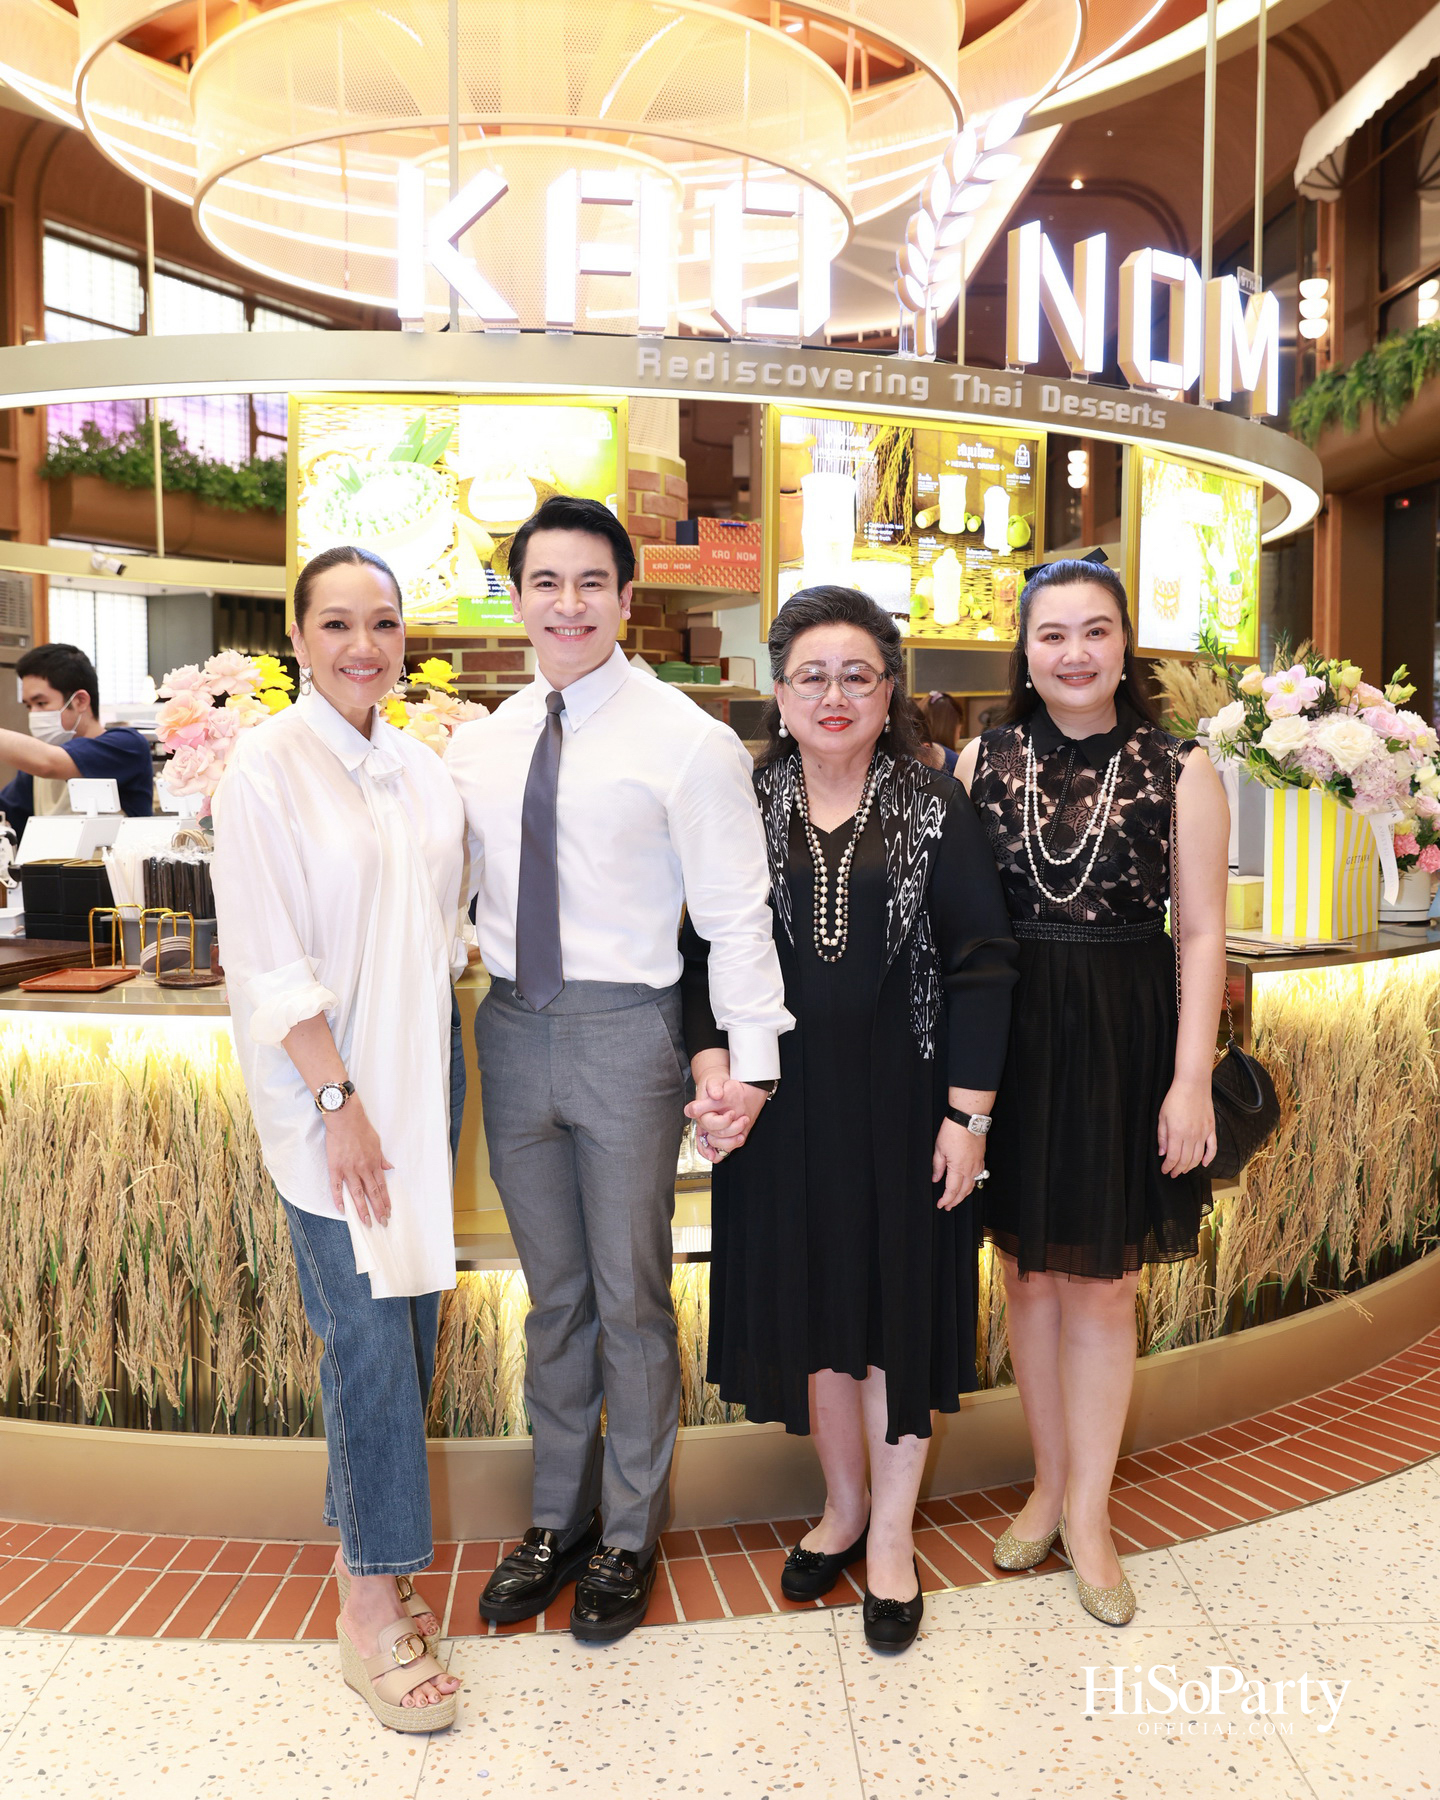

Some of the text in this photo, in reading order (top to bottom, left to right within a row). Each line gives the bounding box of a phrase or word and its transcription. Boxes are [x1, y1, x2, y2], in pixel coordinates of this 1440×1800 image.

[397, 161, 1280, 417] KAO NOM
[637, 347, 1167, 429] Rediscovering Thai Desserts
[712, 549, 757, 561] KAO NOM
